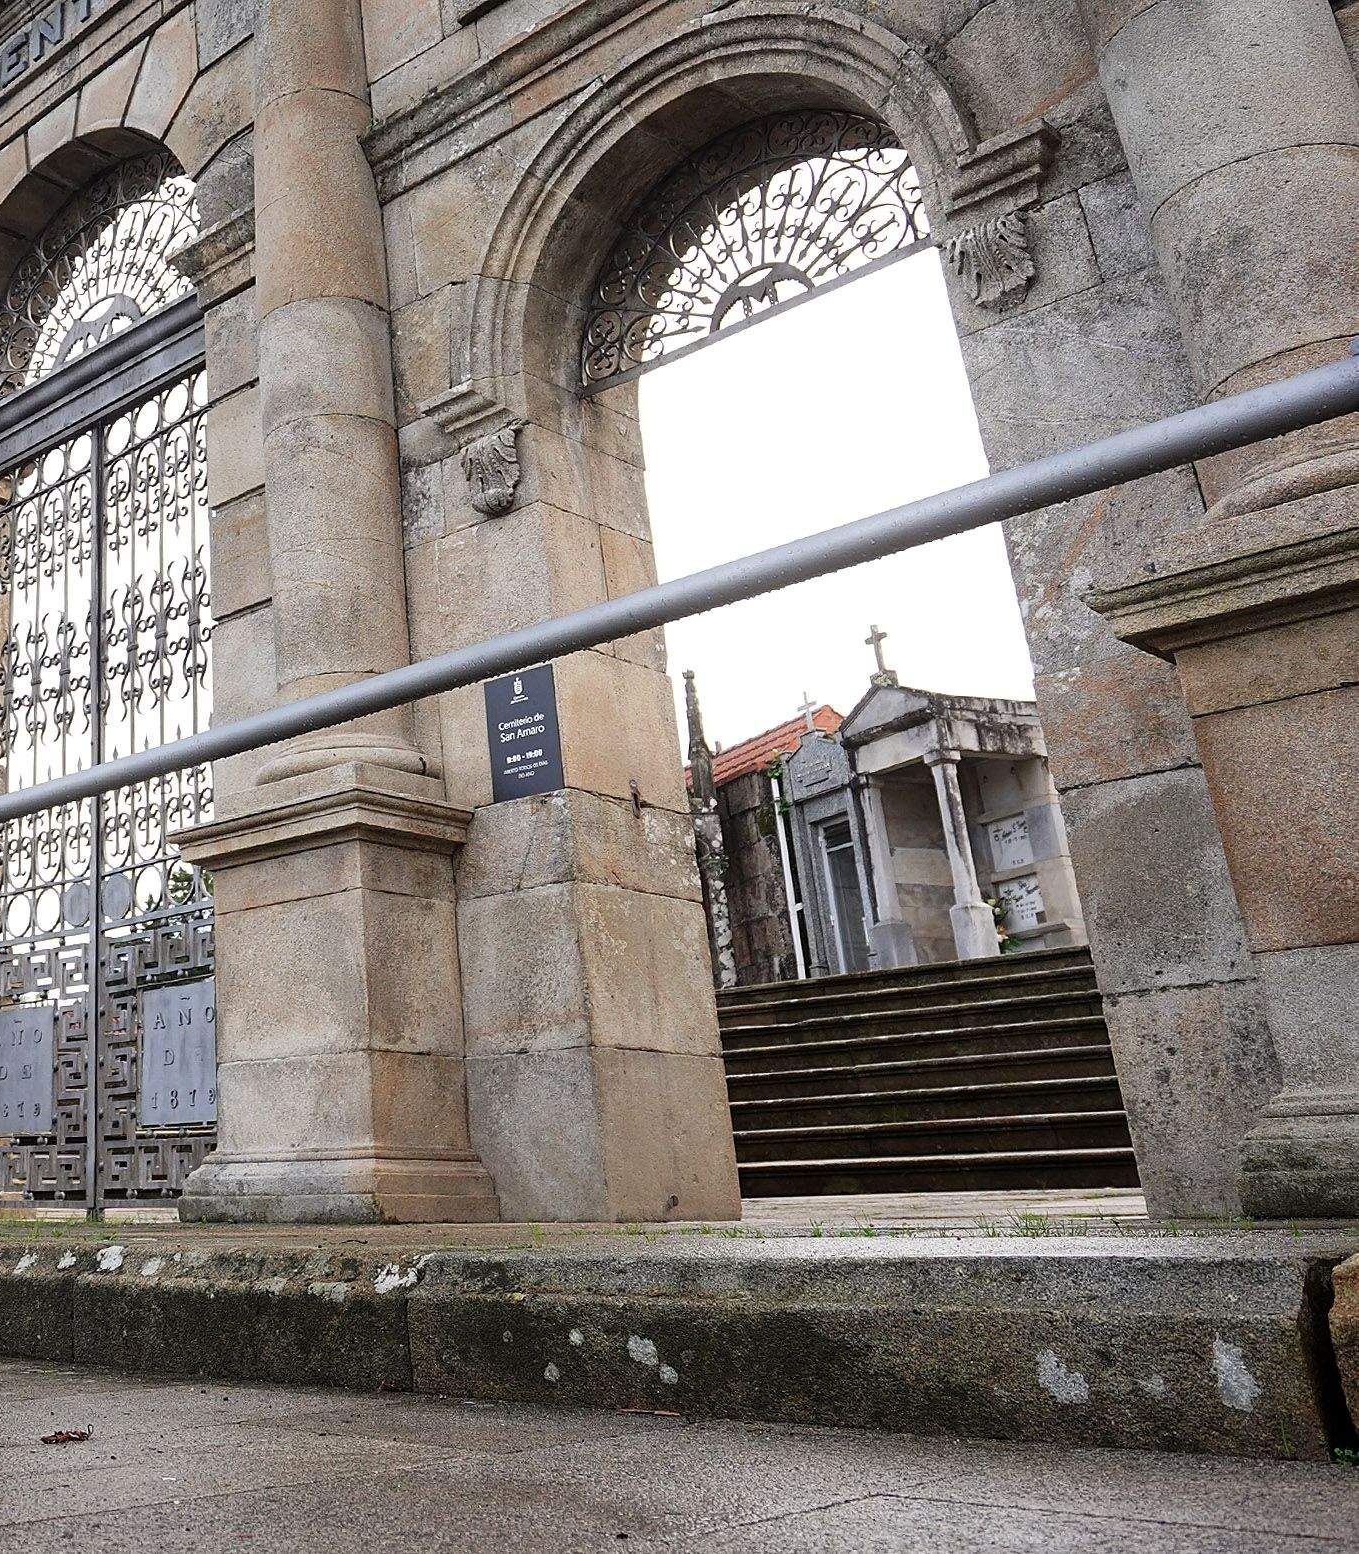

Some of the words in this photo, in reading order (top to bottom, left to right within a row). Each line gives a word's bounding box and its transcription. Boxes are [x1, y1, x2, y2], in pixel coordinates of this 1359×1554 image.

[498, 716, 533, 730] Cemiterio
[534, 713, 545, 721] de
[500, 733, 515, 743] San
[517, 725, 545, 738] Amaro
[152, 995, 215, 1030] AÑO
